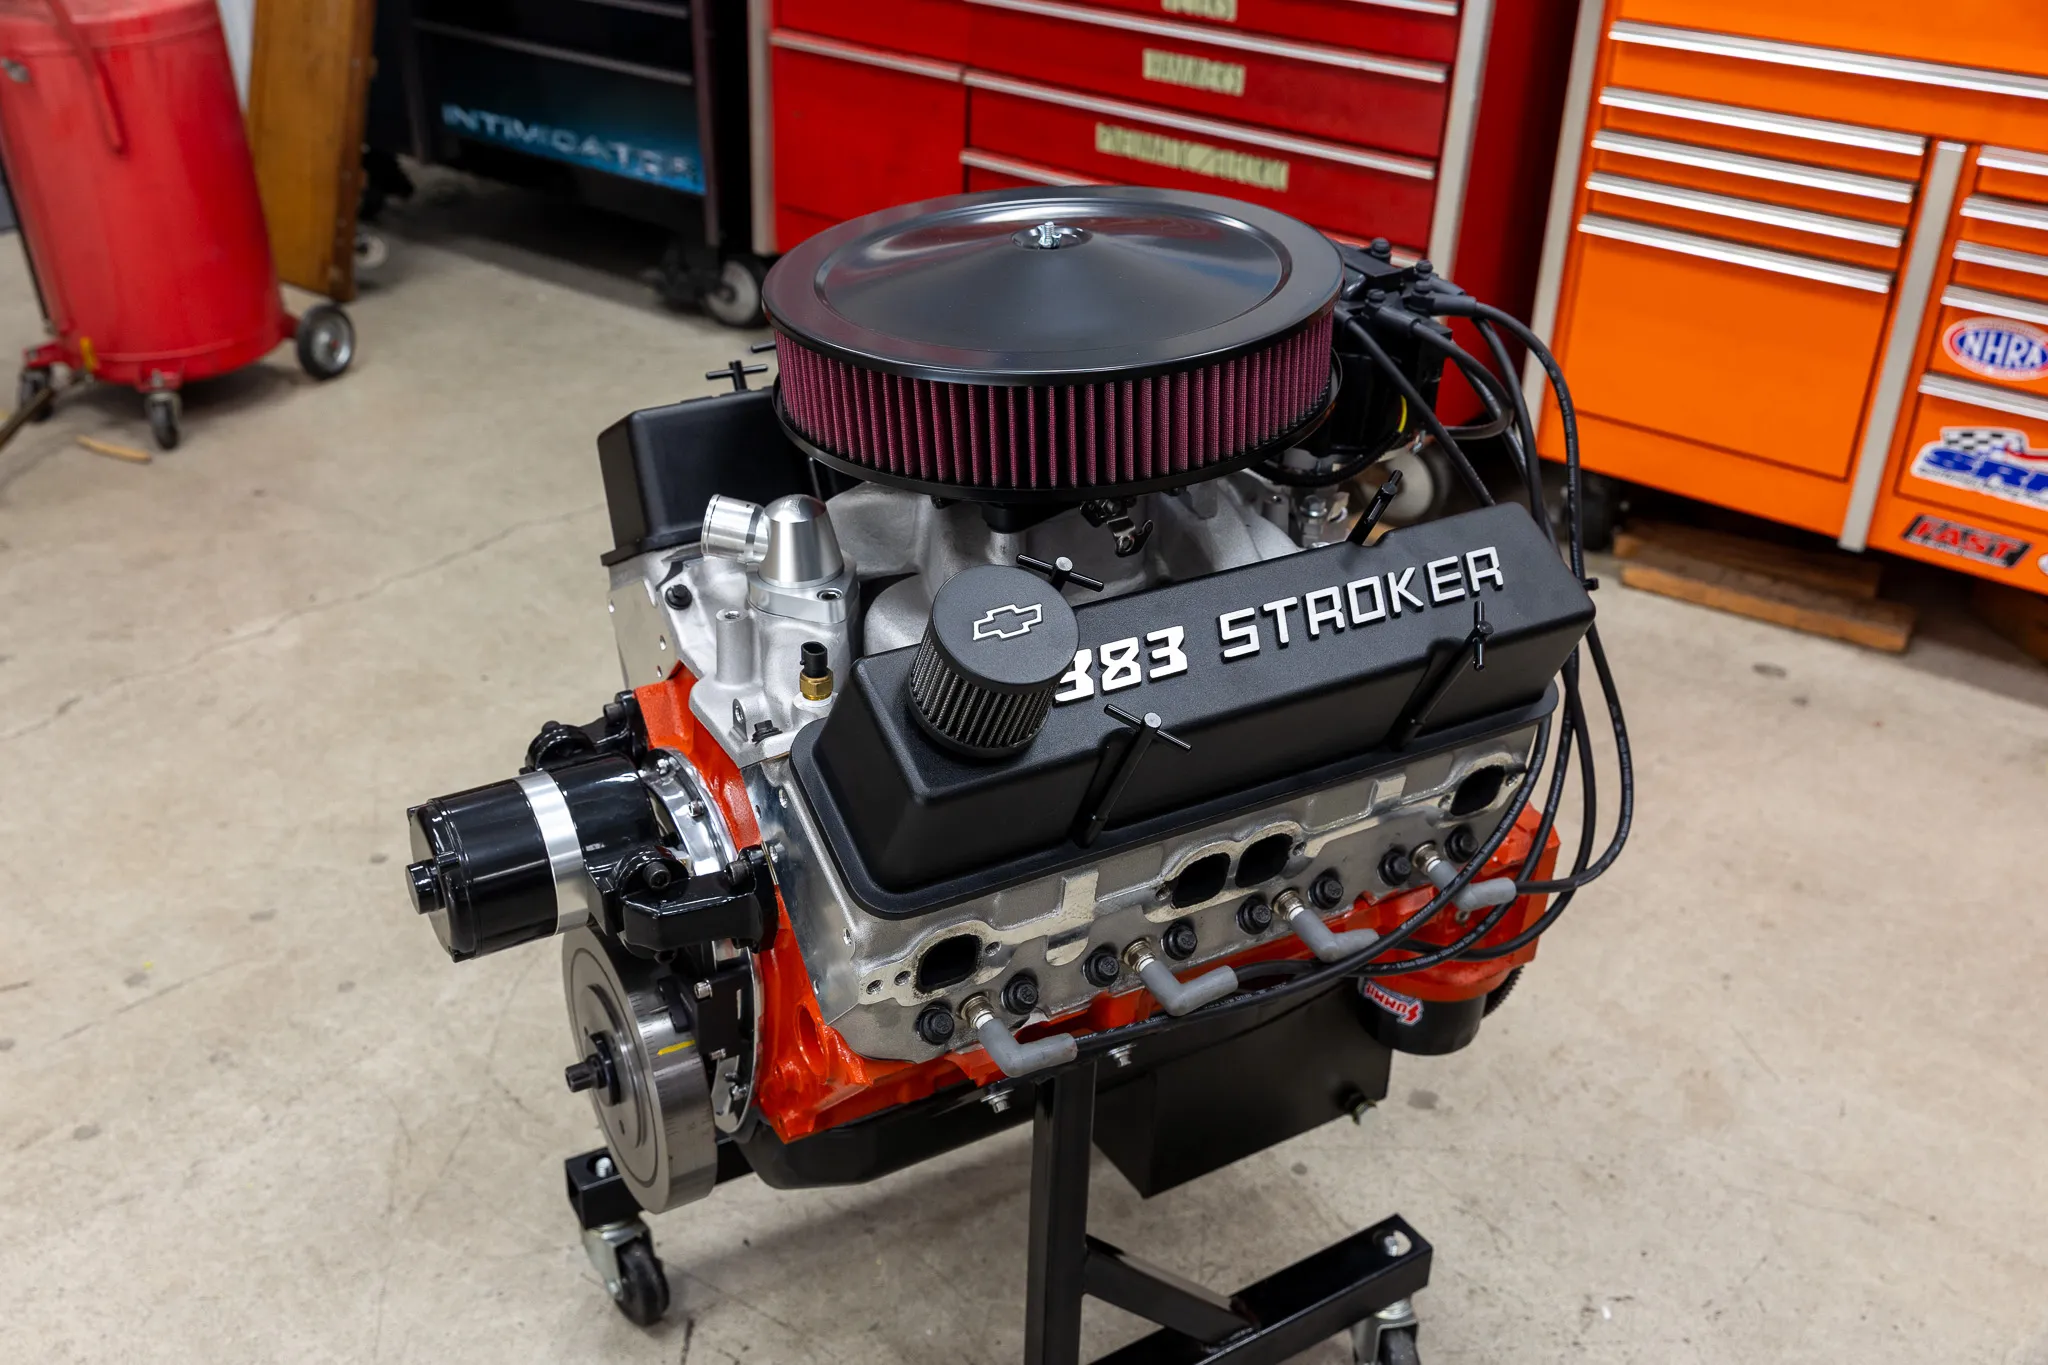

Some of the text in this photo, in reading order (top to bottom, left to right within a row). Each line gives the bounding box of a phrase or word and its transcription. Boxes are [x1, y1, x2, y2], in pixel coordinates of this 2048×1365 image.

[1962, 329, 2043, 369] NHRA
[1912, 521, 2019, 558] FAST
[1055, 546, 1504, 702] 383 STROKER
